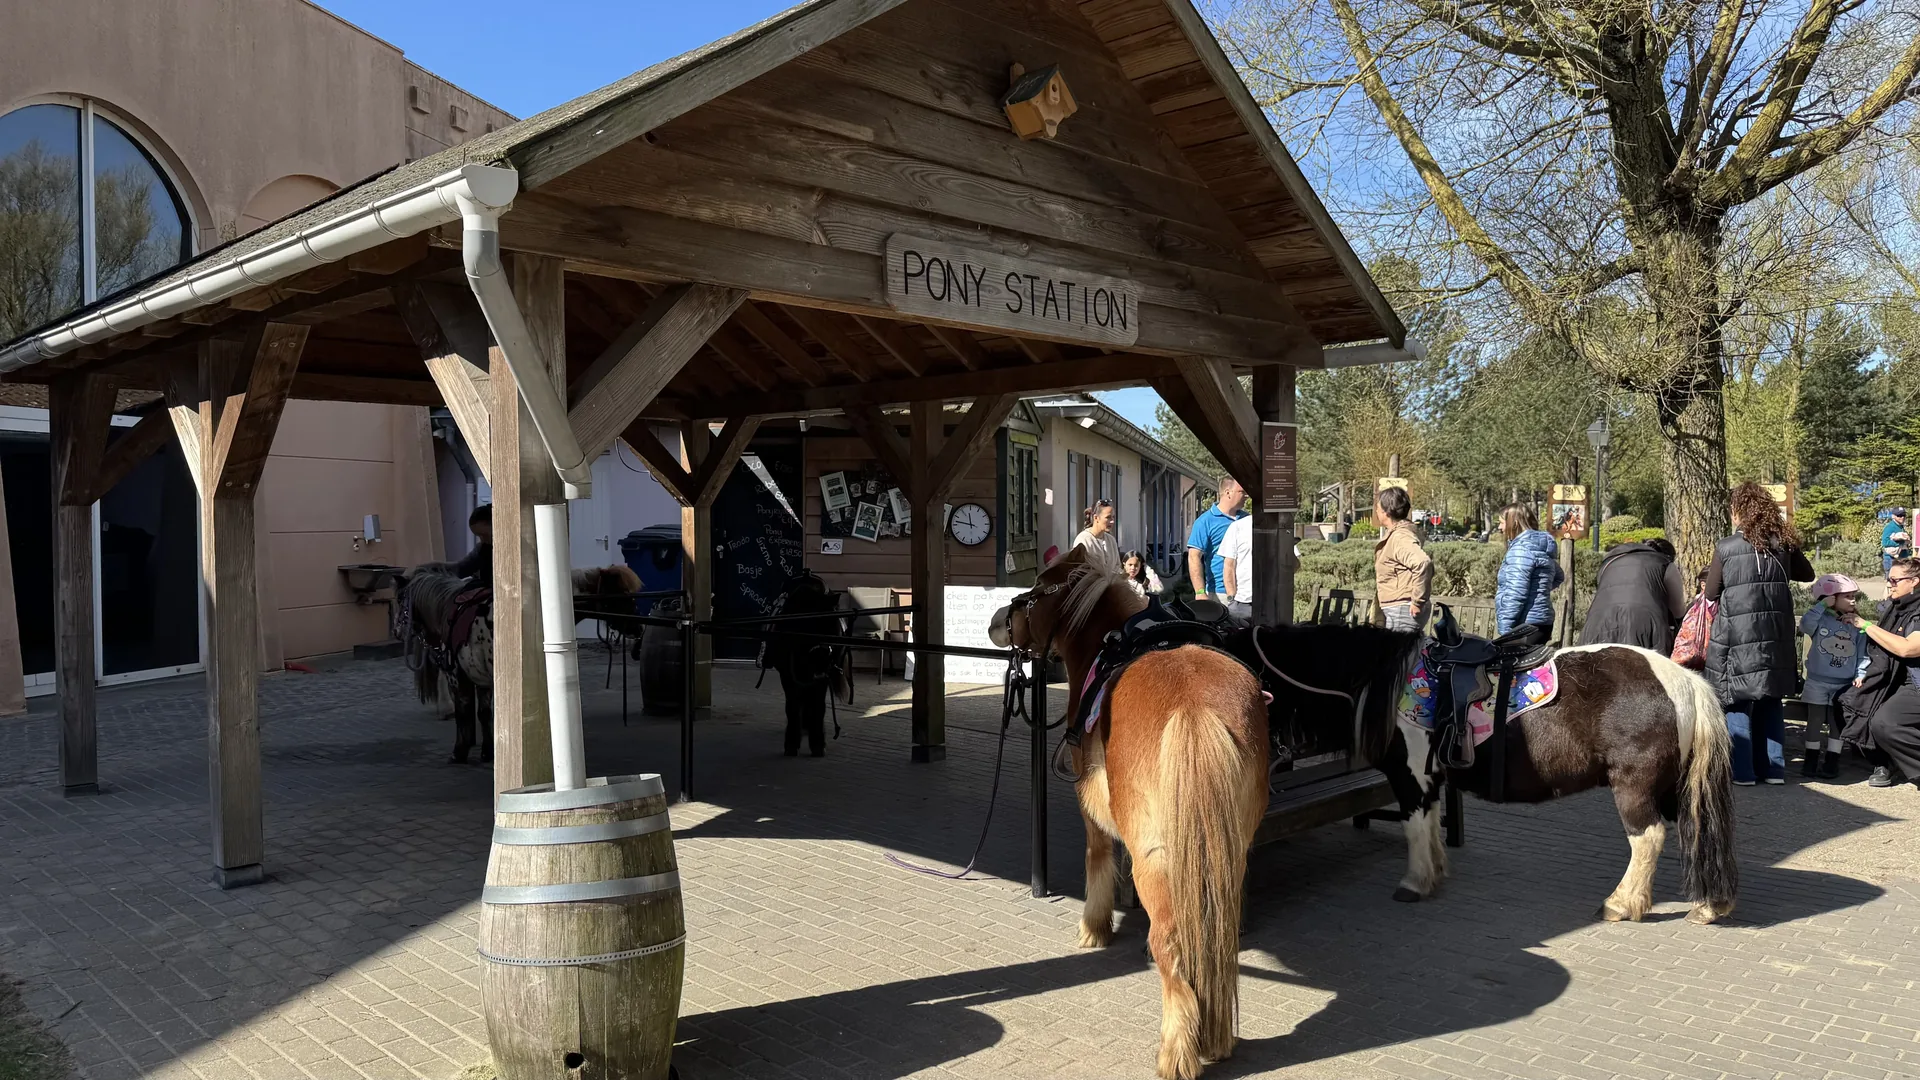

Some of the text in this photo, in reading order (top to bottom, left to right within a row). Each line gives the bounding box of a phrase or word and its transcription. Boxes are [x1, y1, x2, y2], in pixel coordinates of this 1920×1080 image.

[903, 250, 1127, 330] PONY STATION
[763, 524, 783, 538] Pony
[779, 555, 793, 577] Rob
